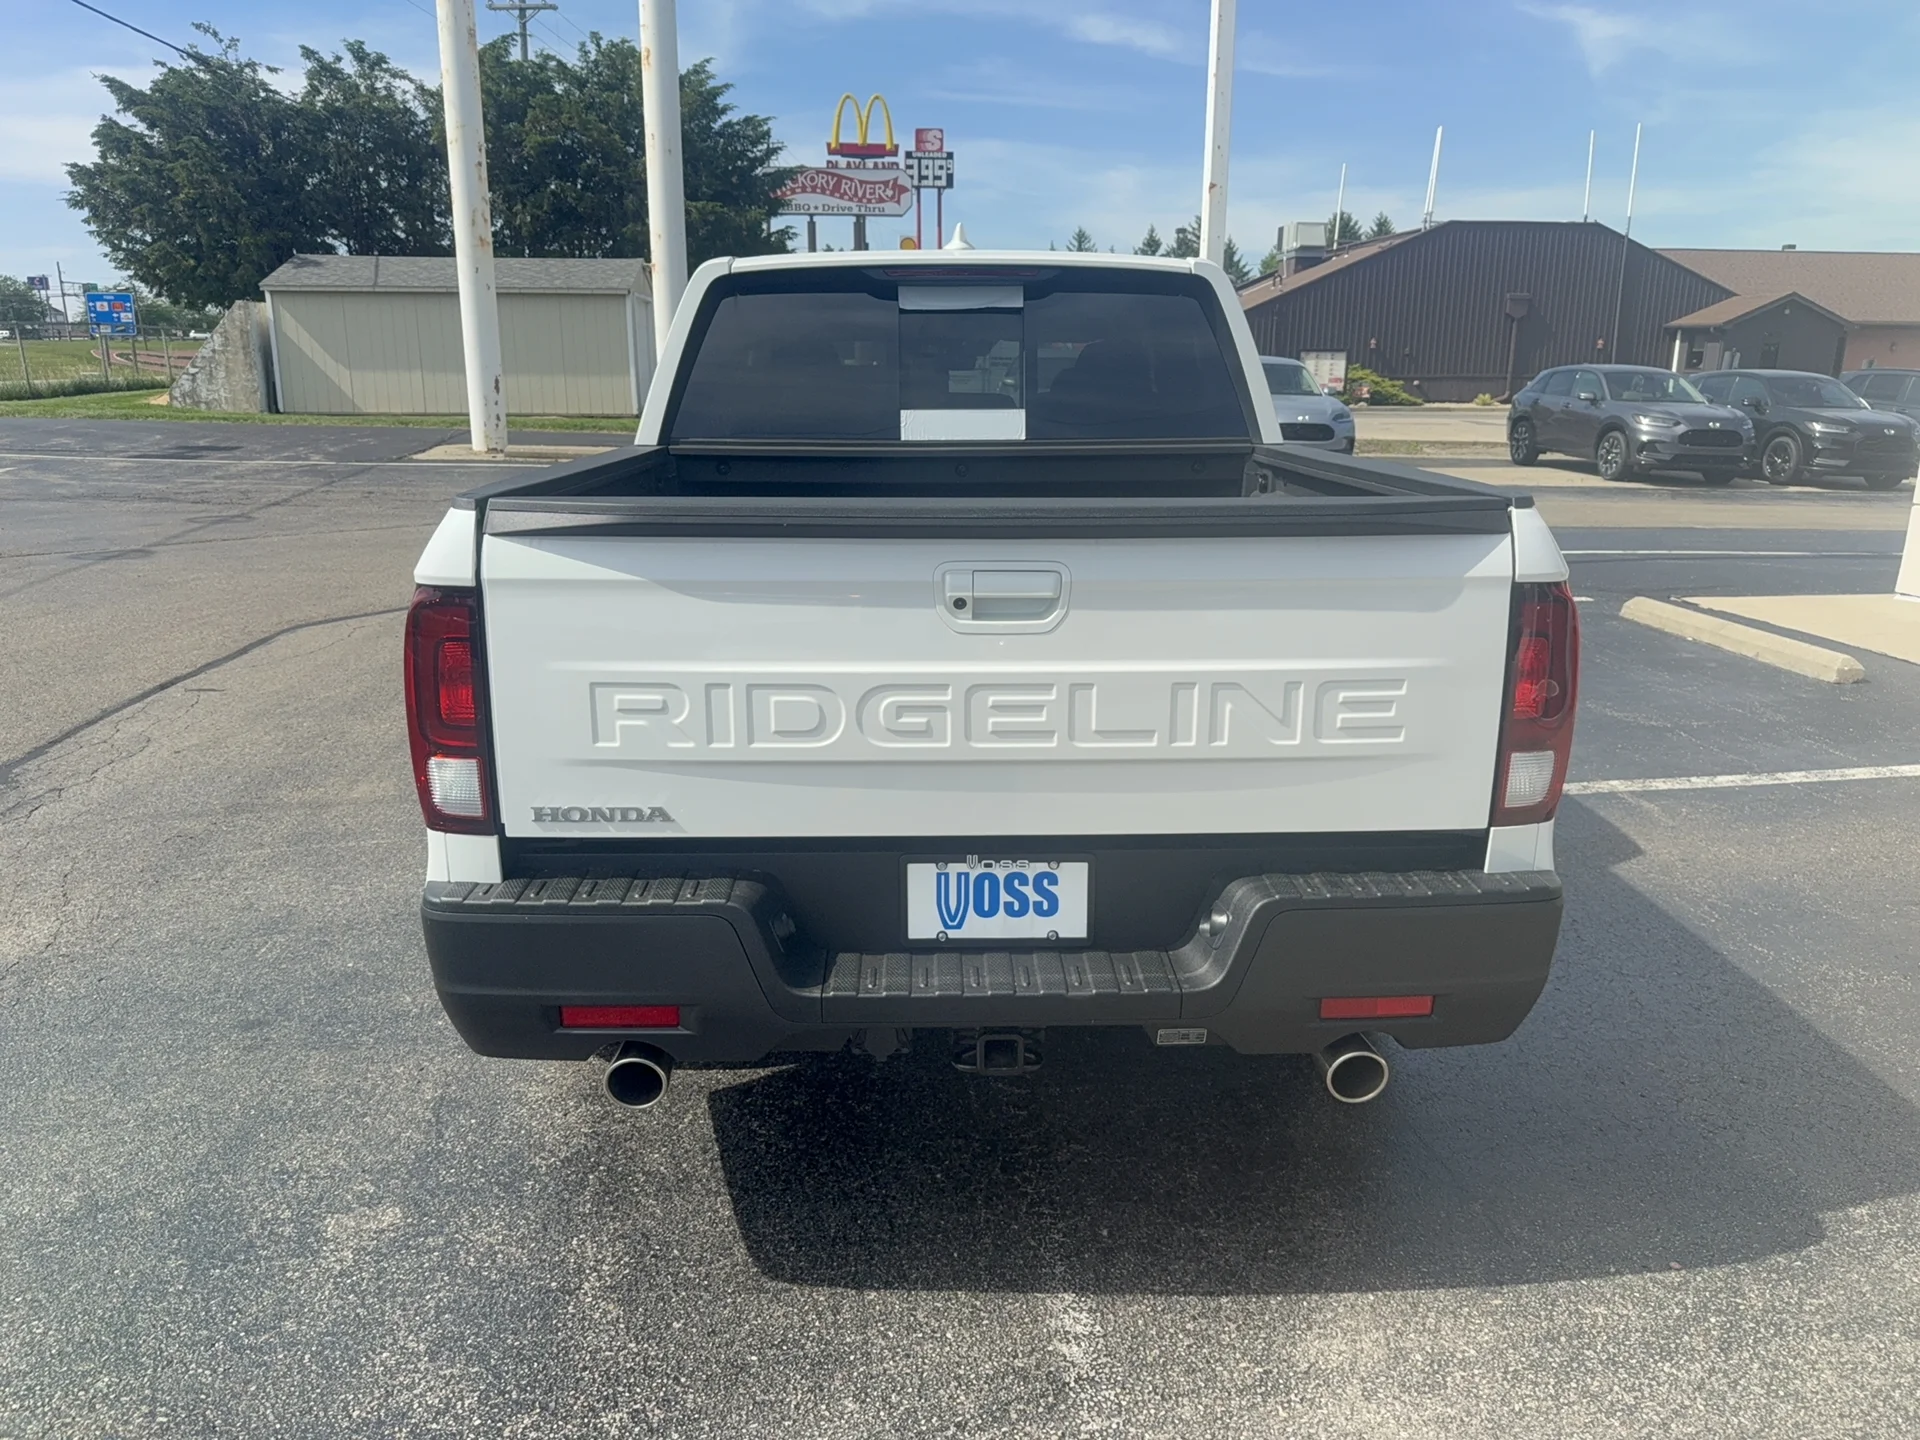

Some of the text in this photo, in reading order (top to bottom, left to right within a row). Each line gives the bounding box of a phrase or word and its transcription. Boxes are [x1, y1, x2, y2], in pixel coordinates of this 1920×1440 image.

[840, 178, 886, 201] RIVER
[822, 203, 854, 213] Drive
[855, 204, 886, 213] Thru
[589, 678, 1408, 749] RIDGELINE
[530, 806, 675, 822] HONDA
